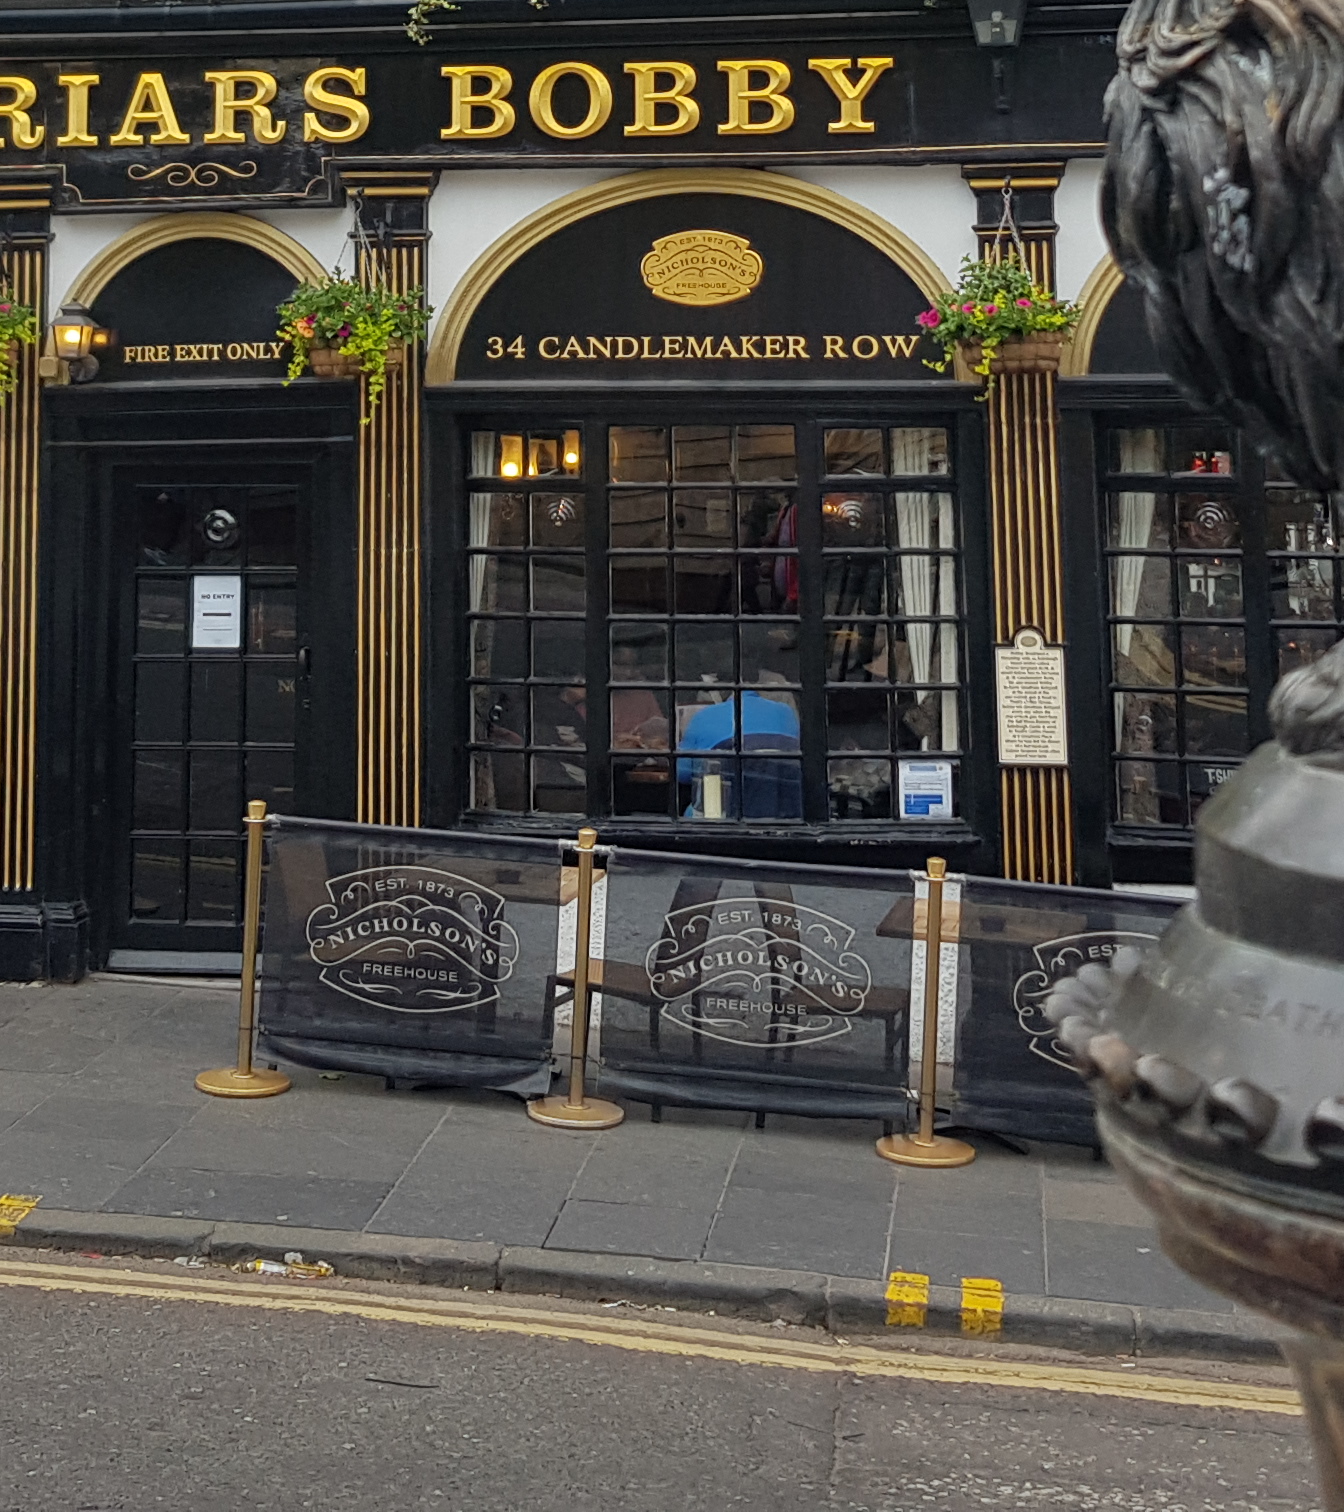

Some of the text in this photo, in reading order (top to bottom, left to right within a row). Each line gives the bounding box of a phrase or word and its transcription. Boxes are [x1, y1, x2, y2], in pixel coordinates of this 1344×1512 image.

[439, 57, 894, 141] BOBBY
[656, 256, 747, 280] NICHOLSON'S
[123, 342, 285, 363] FIRE EXIT ONLY
[485, 334, 920, 360] 34 CANDLEMAKER ROW
[374, 877, 455, 898] EST. 1873
[717, 910, 802, 930] EST. 1873
[327, 917, 497, 965] NICHOLSON'S
[362, 962, 459, 982] FREEHOUSE
[666, 950, 848, 998] NICHOLSON'S
[706, 997, 808, 1015] FREEHOUSE
